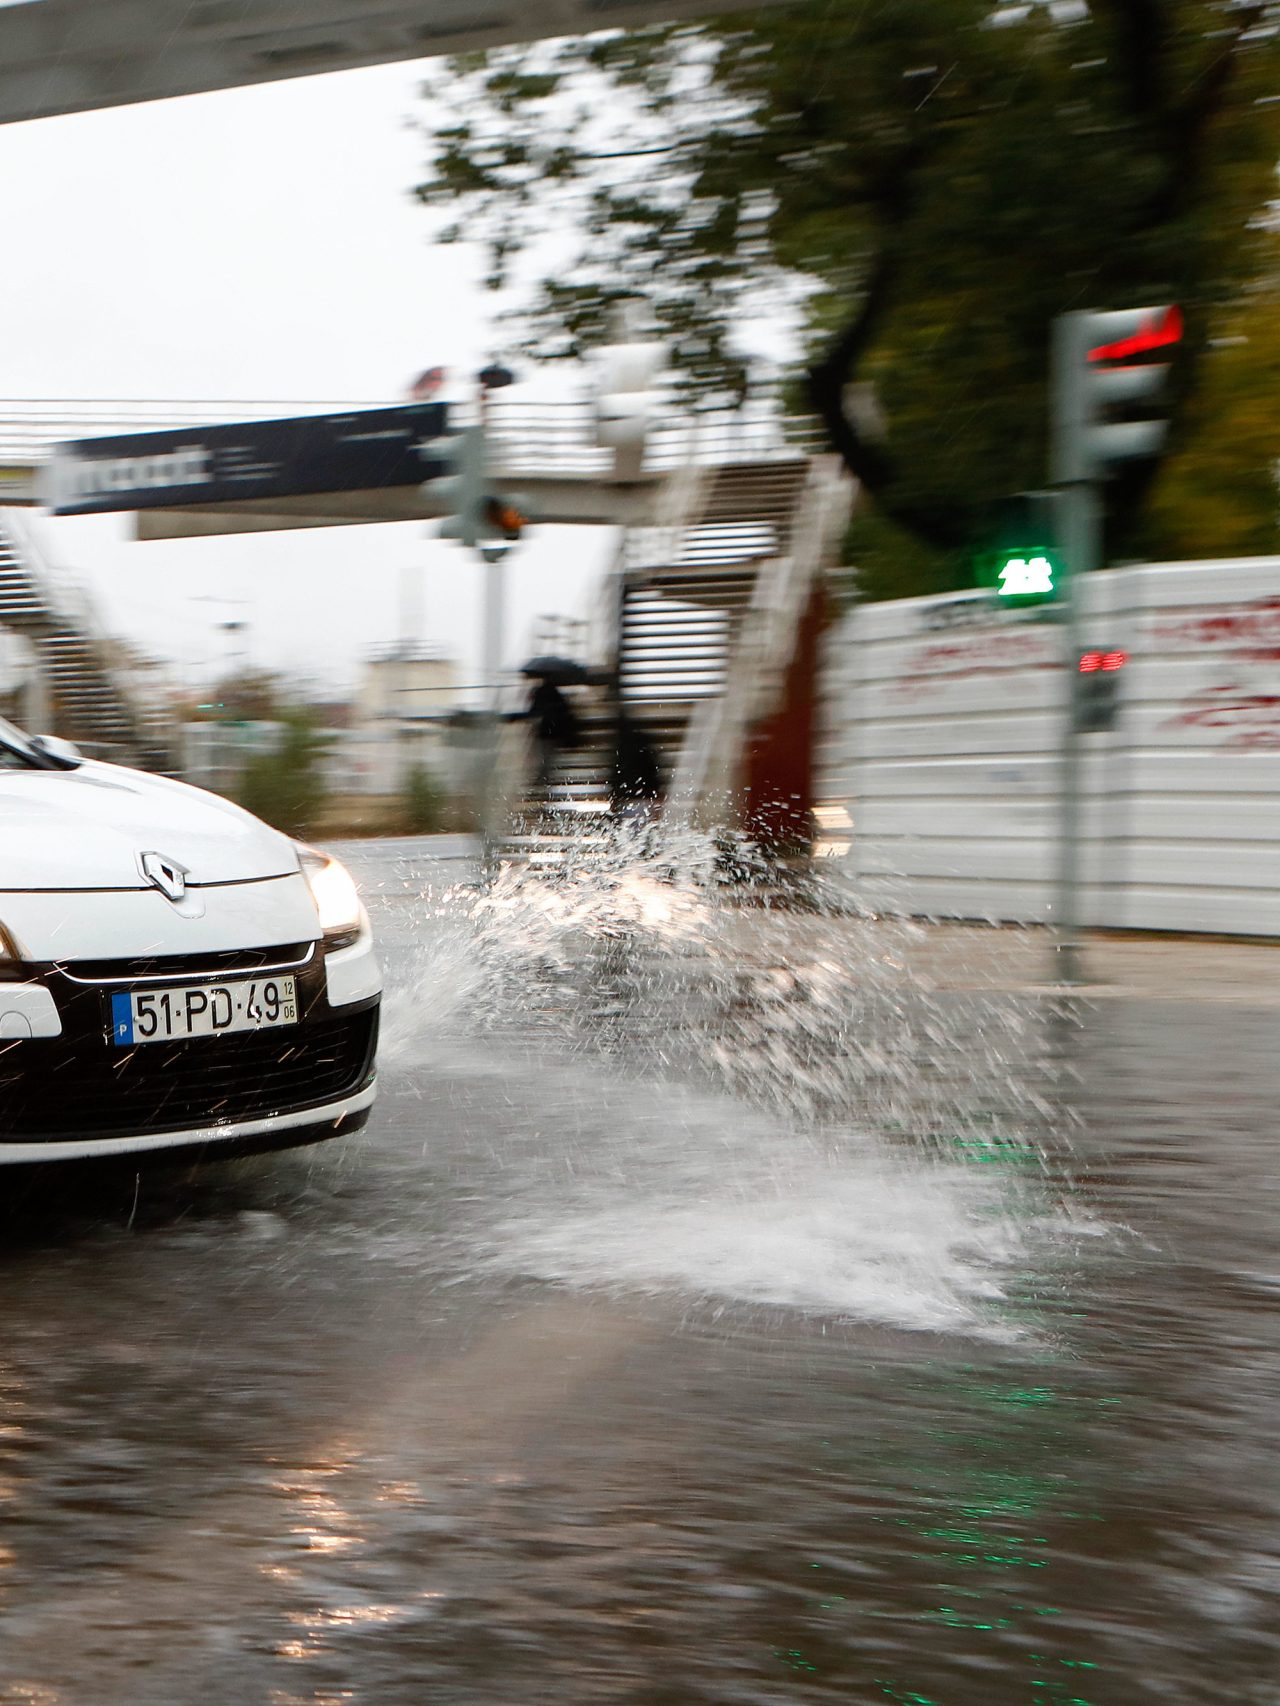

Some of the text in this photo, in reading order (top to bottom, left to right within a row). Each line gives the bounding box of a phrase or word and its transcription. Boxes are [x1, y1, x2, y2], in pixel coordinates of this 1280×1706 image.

[284, 981, 293, 995] 12
[283, 1005, 295, 1019] 06
[119, 1023, 128, 1037] P
